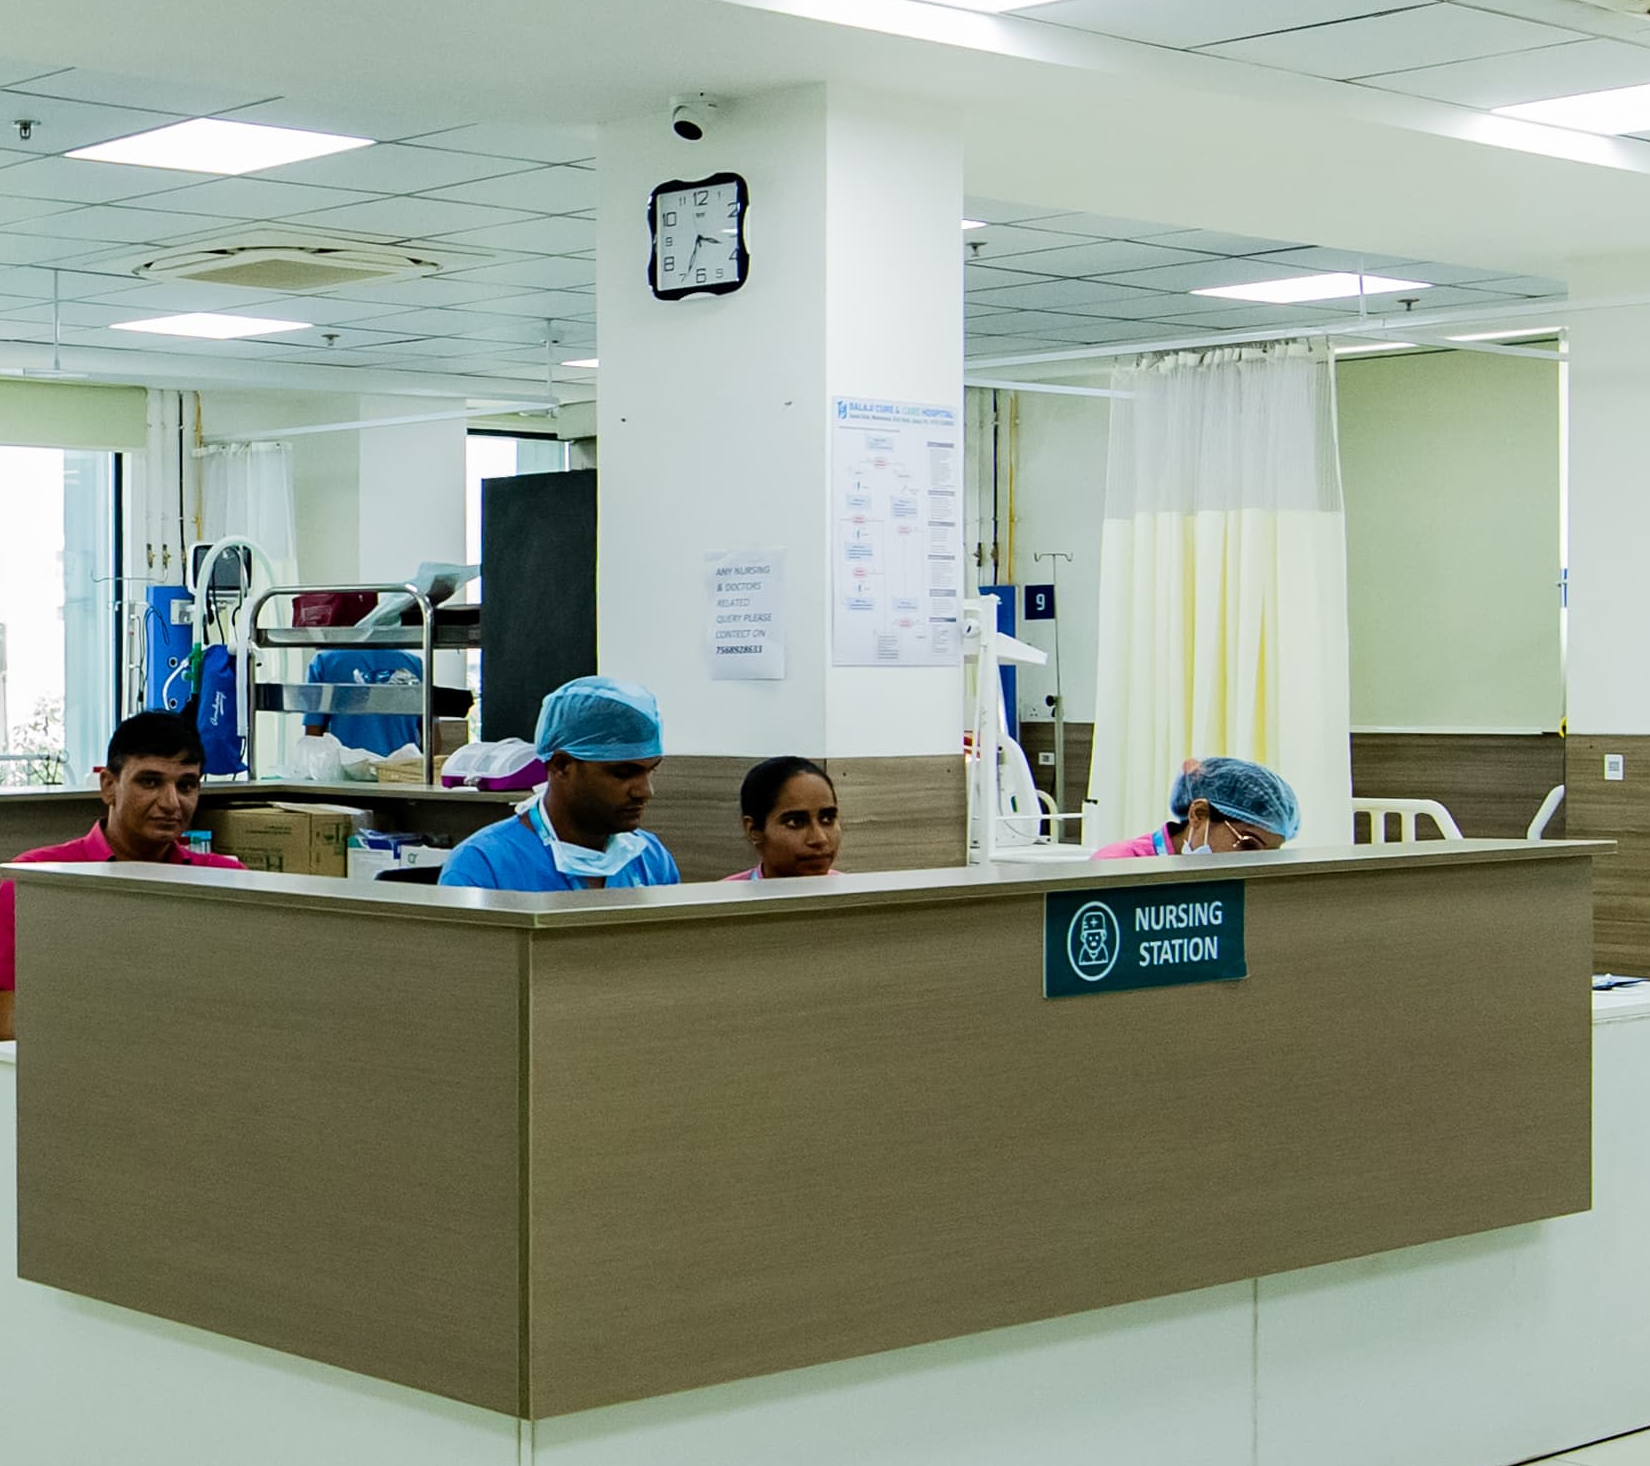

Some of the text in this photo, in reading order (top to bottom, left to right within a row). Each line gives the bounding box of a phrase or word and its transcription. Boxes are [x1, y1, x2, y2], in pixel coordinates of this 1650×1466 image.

[693, 190, 708, 206] 12
[662, 212, 677, 227] 10
[664, 256, 675, 272] 8
[696, 268, 707, 283] 6
[716, 565, 771, 576] ANY NURSING
[725, 581, 762, 592] DOCTORS
[717, 598, 749, 607] RELATED
[1036, 593, 1045, 610] 9
[716, 612, 772, 624] QUERY PLEASE
[1135, 900, 1223, 932] NURSING
[1139, 935, 1219, 967] STATION
